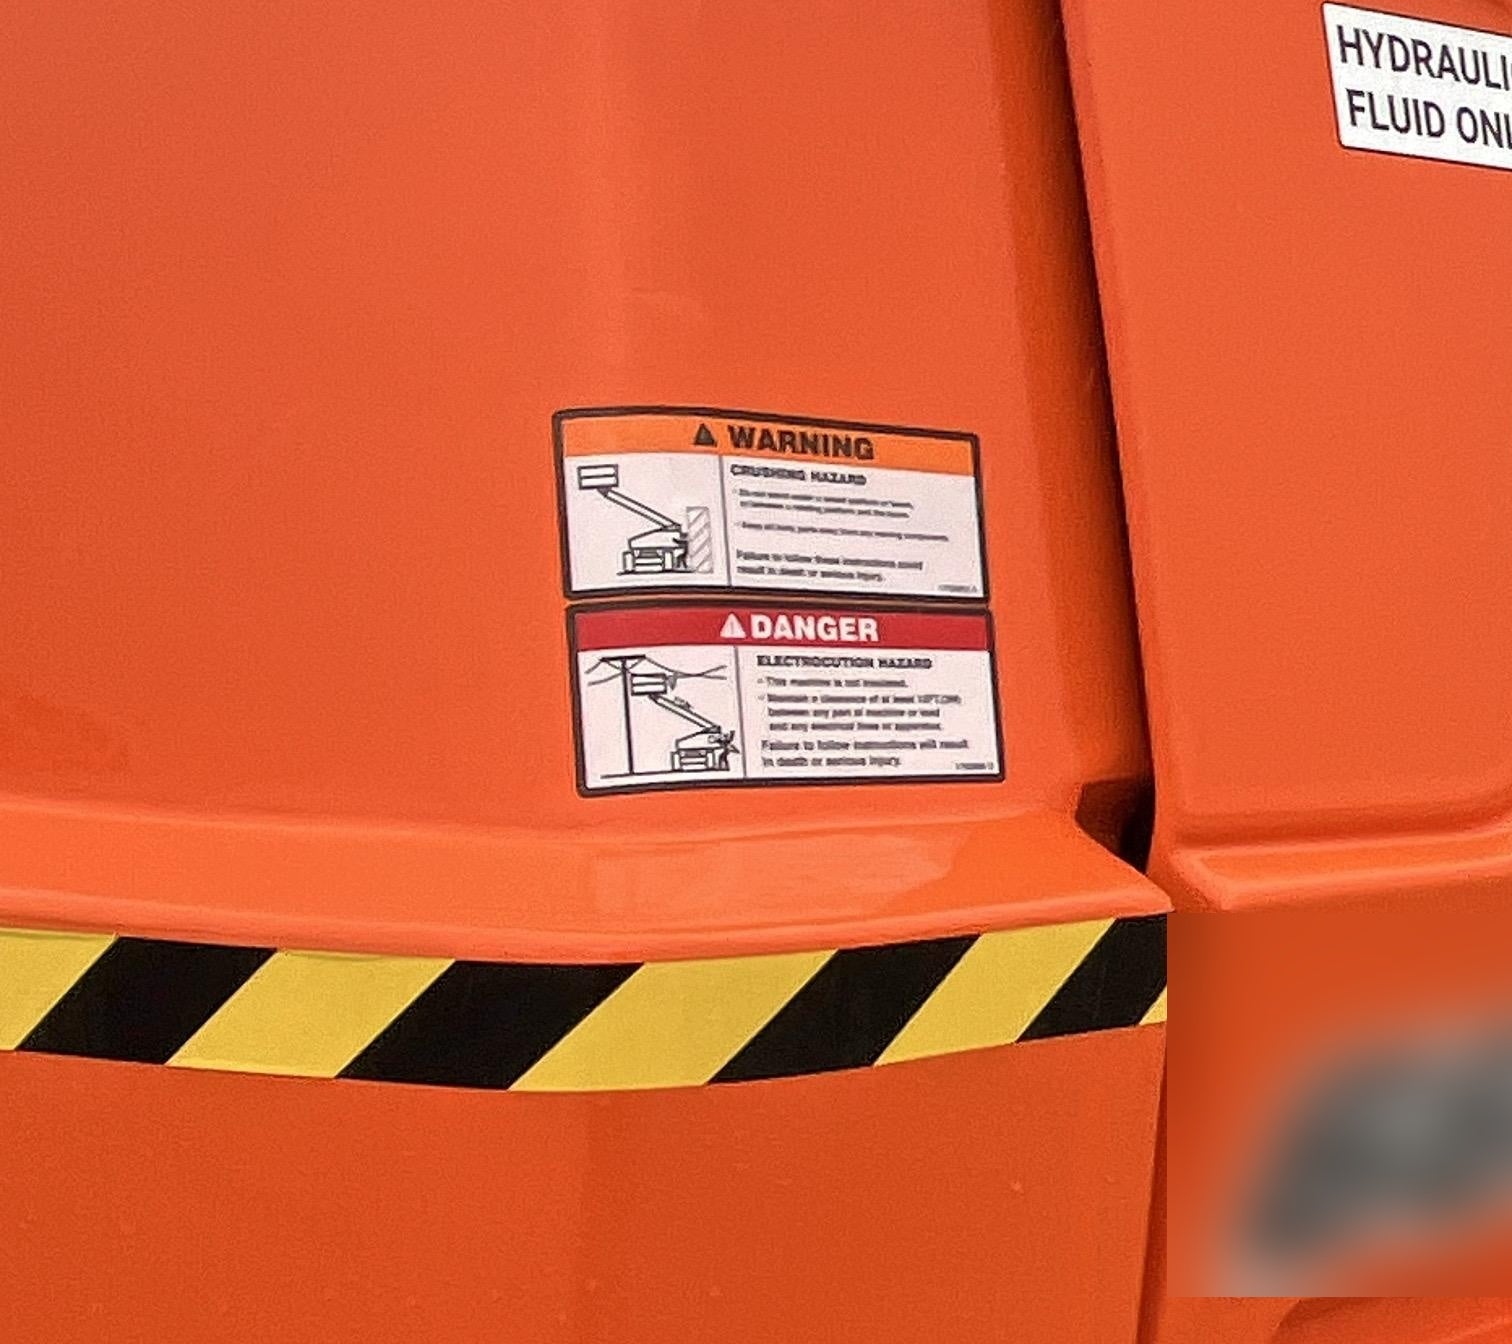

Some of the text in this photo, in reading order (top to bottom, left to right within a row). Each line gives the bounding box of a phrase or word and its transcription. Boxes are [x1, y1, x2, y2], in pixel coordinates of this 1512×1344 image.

[1345, 87, 1446, 138] FLUID
[727, 424, 875, 460] WARNING
[750, 614, 880, 643] DANGER
